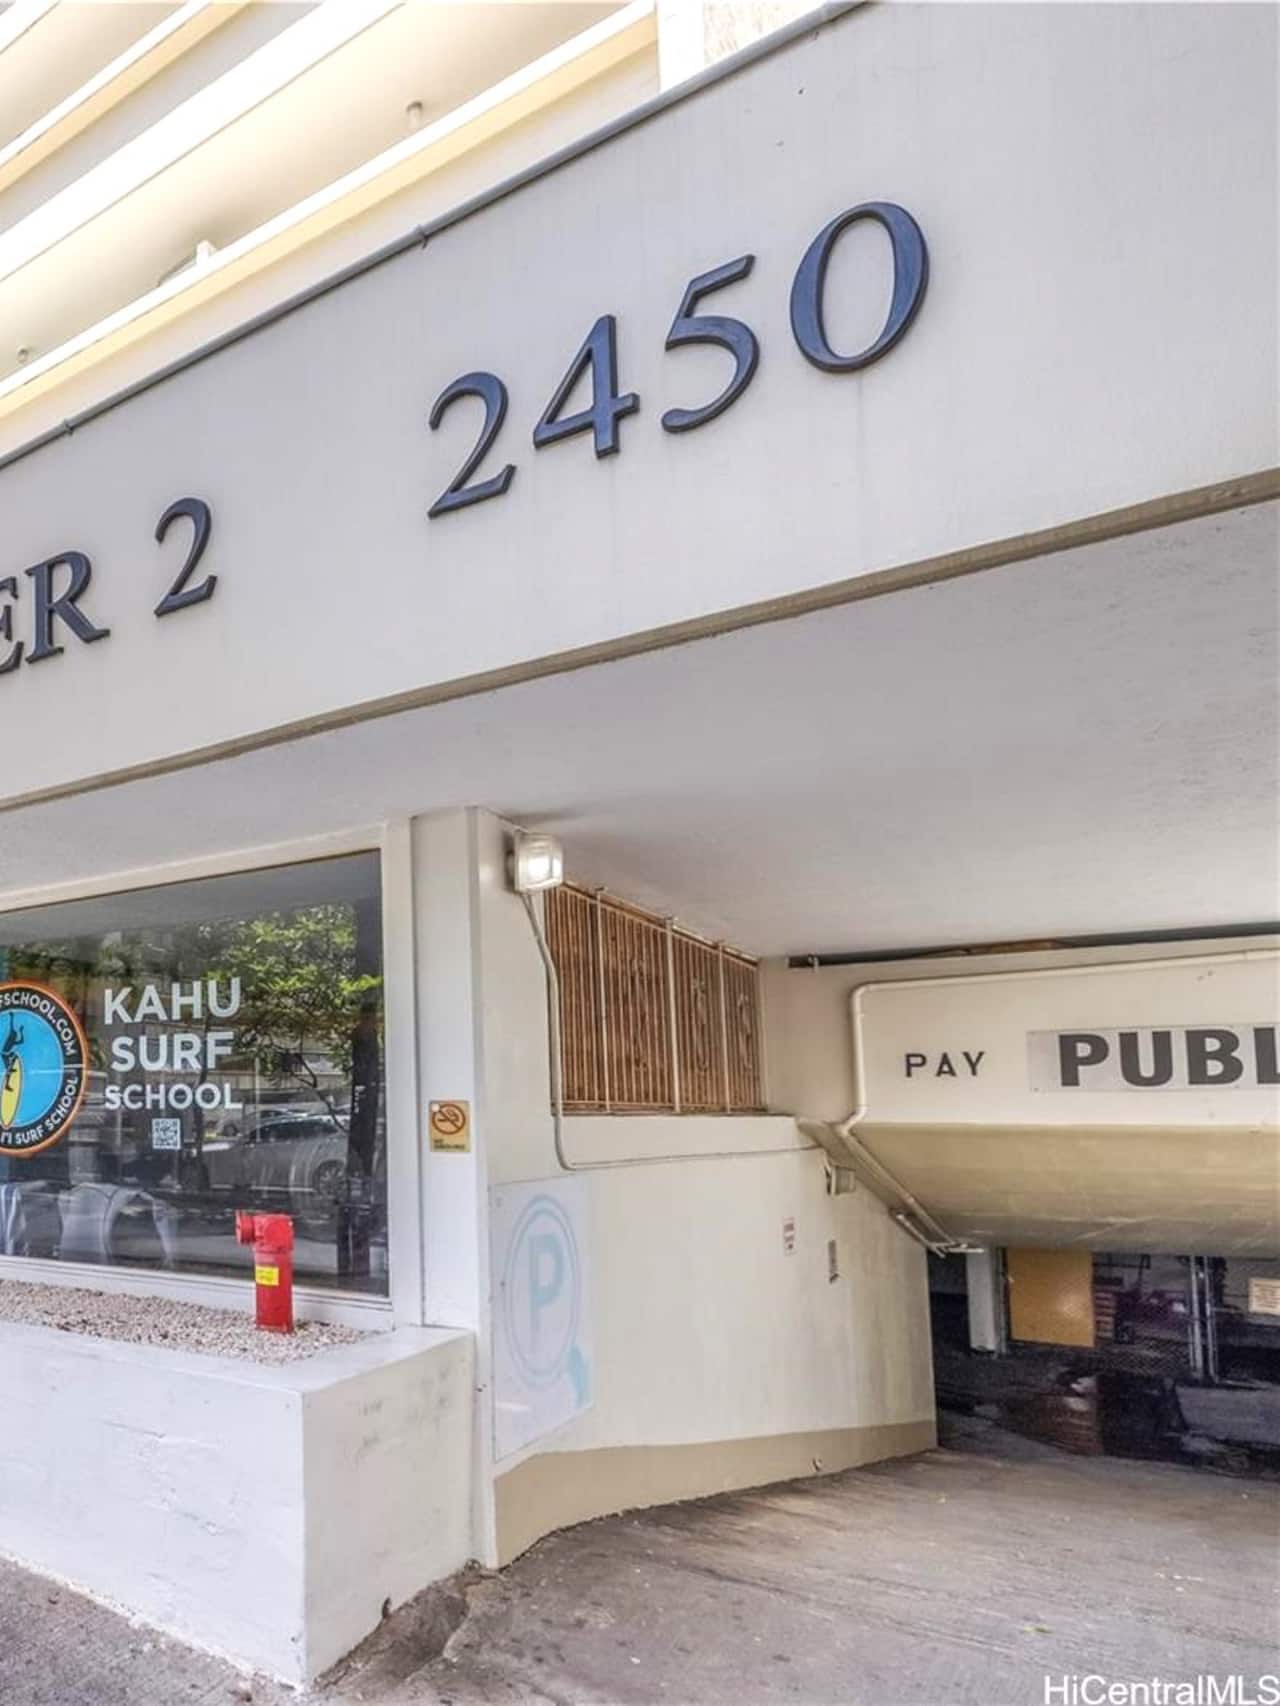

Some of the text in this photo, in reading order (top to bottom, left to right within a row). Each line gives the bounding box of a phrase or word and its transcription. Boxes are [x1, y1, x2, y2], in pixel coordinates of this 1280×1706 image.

[428, 201, 931, 520] 2450
[154, 497, 218, 618] 2
[104, 977, 241, 1025] KAHU
[110, 1031, 235, 1072] SURF
[904, 1027, 1280, 1087] PAY PUBL
[15, 1126, 46, 1145] SURF
[45, 1068, 78, 1129] SCHOOL
[104, 1082, 243, 1110] SCHOOL
